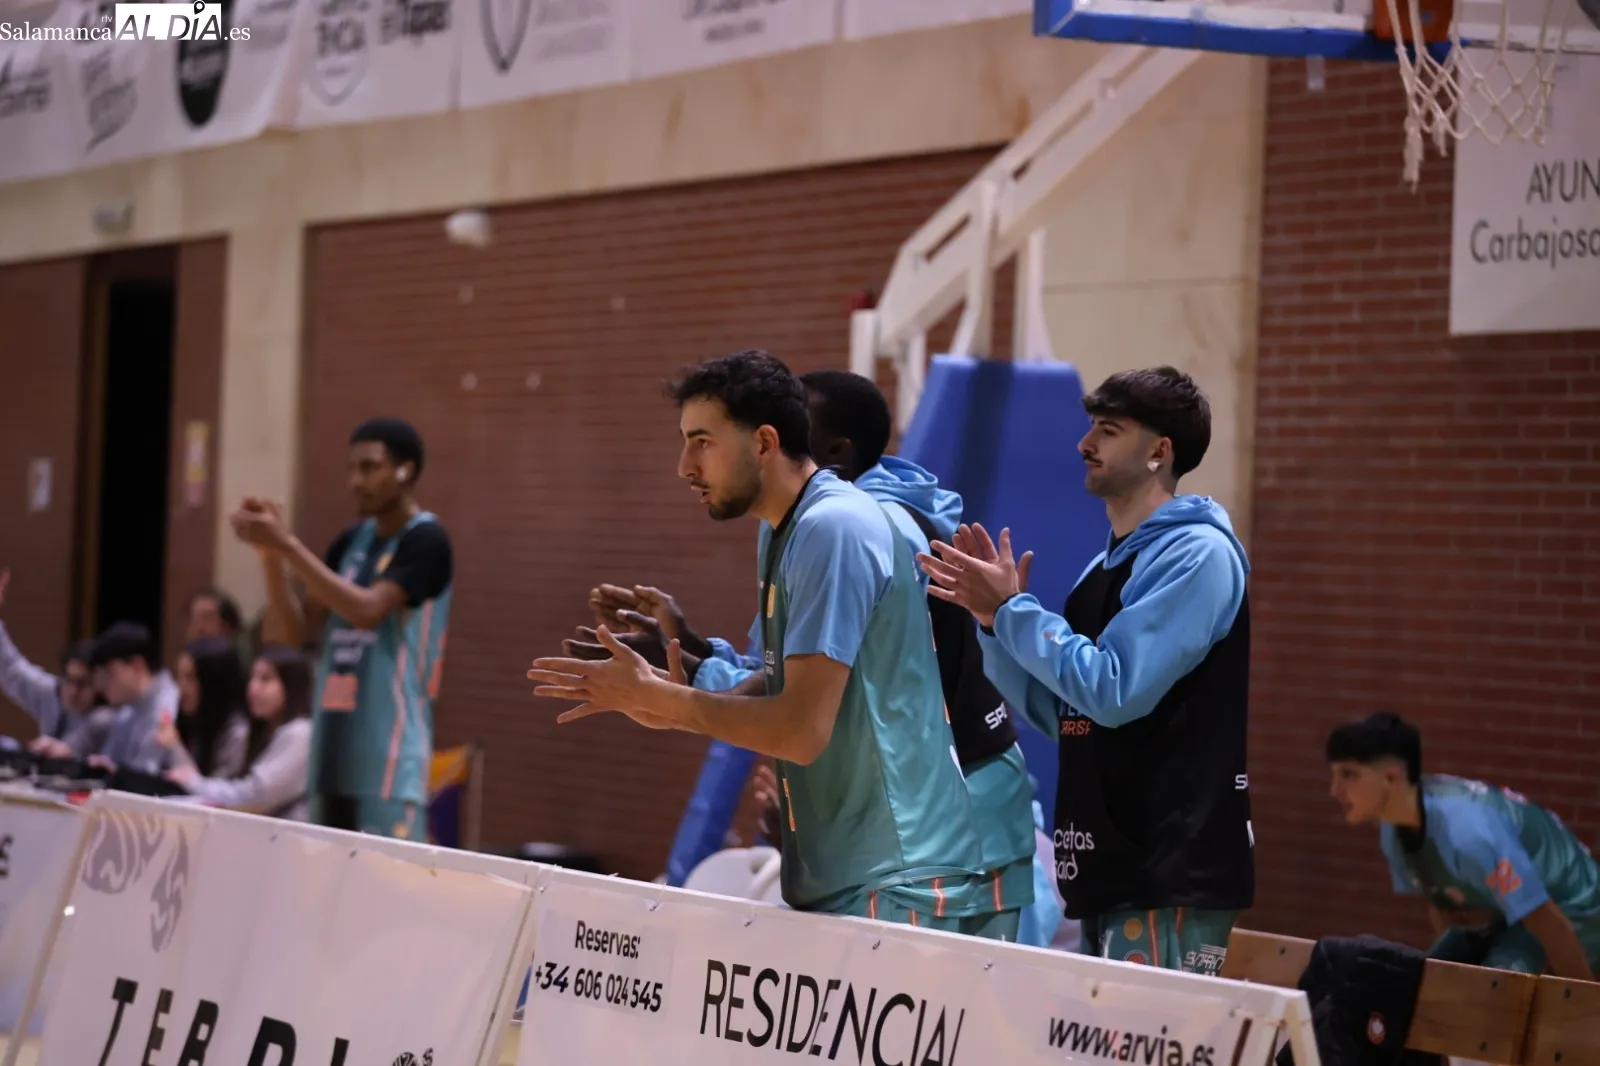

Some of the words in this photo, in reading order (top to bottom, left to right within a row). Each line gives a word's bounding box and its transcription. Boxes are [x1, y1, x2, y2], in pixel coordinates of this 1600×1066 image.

[574, 919, 641, 959] Reservas:
[534, 961, 570, 993] +34
[573, 967, 603, 1001] 606
[605, 972, 630, 1006] 024
[630, 978, 663, 1013] 545
